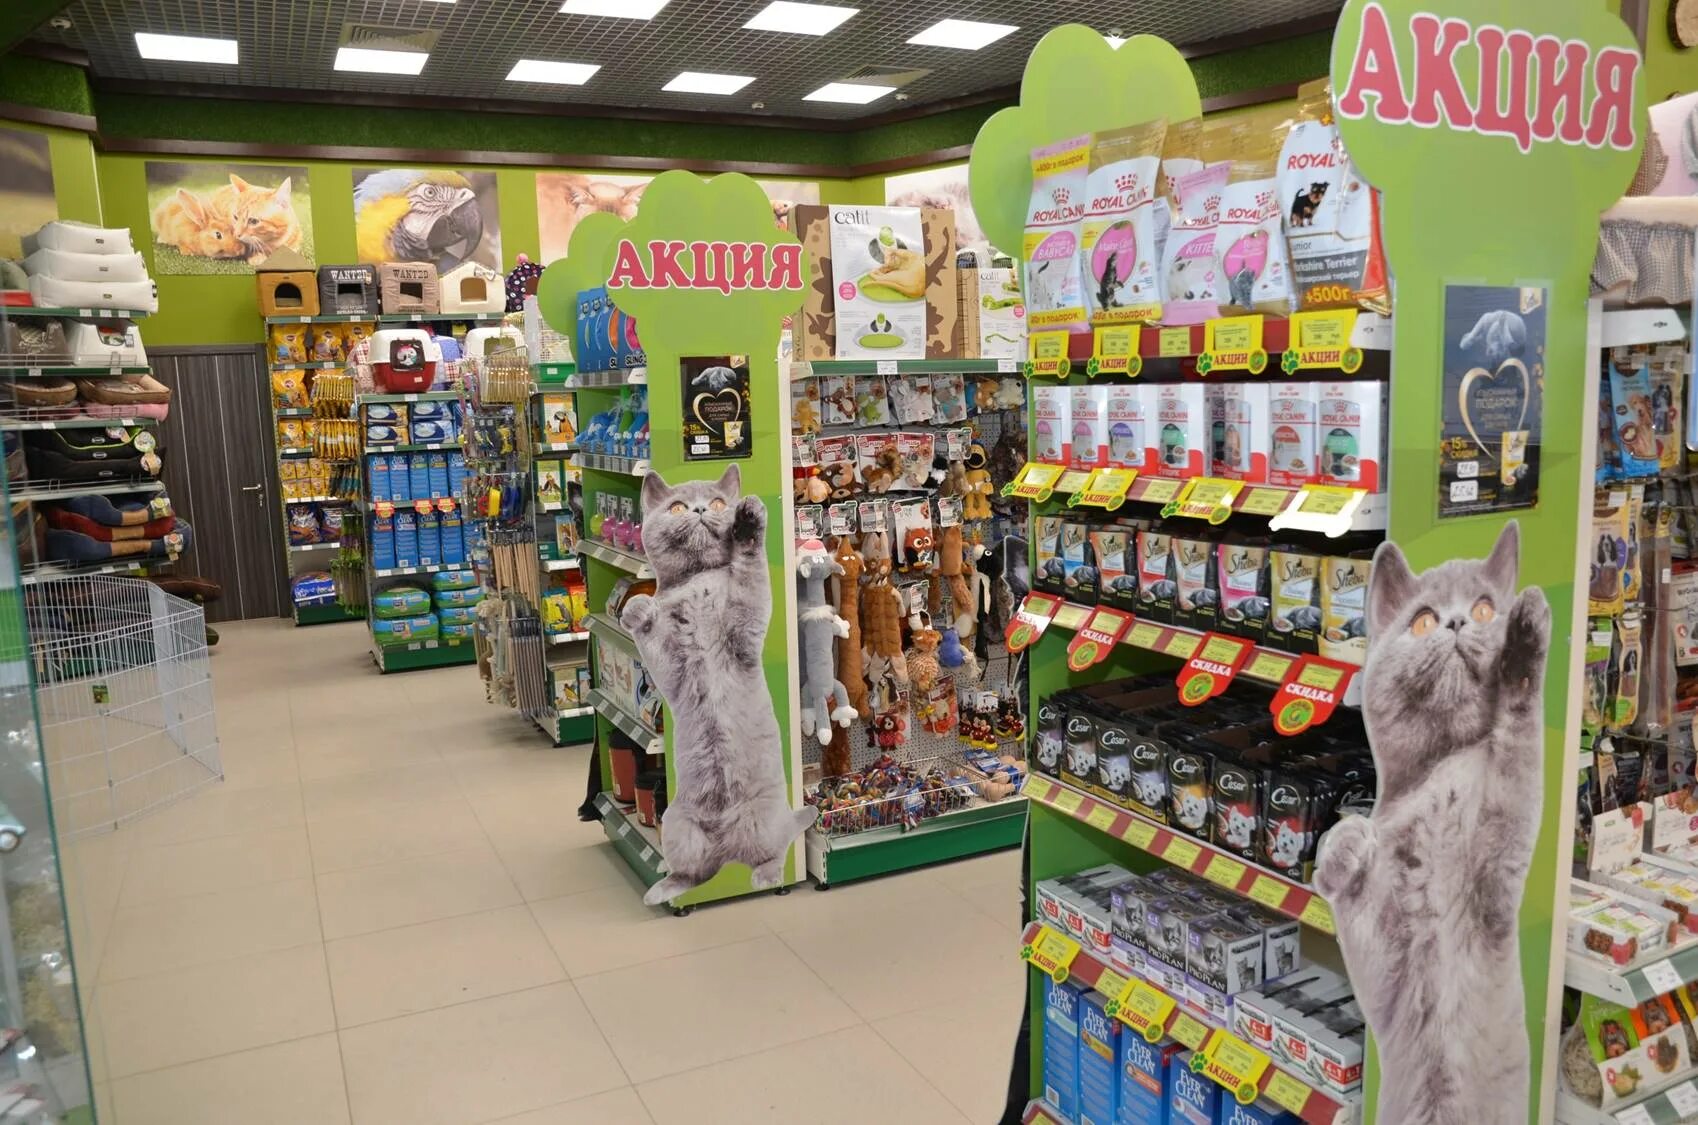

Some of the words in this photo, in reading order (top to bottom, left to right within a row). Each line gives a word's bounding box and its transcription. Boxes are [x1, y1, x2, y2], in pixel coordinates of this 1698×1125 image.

[1337, 2, 1641, 154] АКЦИЯ
[1287, 154, 1336, 170] ROYAL
[1092, 197, 1124, 210] ROYAL
[835, 209, 870, 225] catit
[1033, 209, 1061, 222] ROYAL
[1227, 208, 1260, 219] ROYAL
[607, 239, 804, 296] АКЦИЯ
[1325, 256, 1358, 270] Terrier
[393, 269, 428, 279] WANTED
[1101, 358, 1127, 369] АКЦИИ
[1214, 352, 1249, 366] АКЦИИ
[1301, 350, 1340, 364] АКЦИИ
[1228, 554, 1259, 574] Sheba
[1283, 561, 1313, 581] Sheba
[1333, 569, 1365, 590] Sheba
[1081, 629, 1113, 645] СКИДКА
[1190, 659, 1232, 676] СКИДКА
[1285, 683, 1334, 703] СКИДКА
[1068, 719, 1090, 733] Cesar
[1102, 731, 1127, 745] Cesar
[1134, 745, 1158, 760] Cesar
[1173, 758, 1197, 773] Cesar
[1220, 774, 1247, 791] Cesar
[1271, 788, 1298, 805] Cesar
[1126, 932, 1145, 948] PLAN
[1164, 954, 1184, 969] PLAN
[1203, 975, 1227, 991] PLAN
[1048, 992, 1072, 1015] CLEAN
[1087, 1007, 1105, 1028] EVER
[1122, 1007, 1150, 1029] АКЦИИ
[1083, 1017, 1108, 1041] CLEAN
[1132, 1038, 1151, 1058] EVER
[1128, 1049, 1155, 1075] CLEAN
[1180, 1068, 1201, 1087] EVER
[1207, 1062, 1241, 1088] АКЦИИ
[1175, 1079, 1205, 1107] CLEAN
